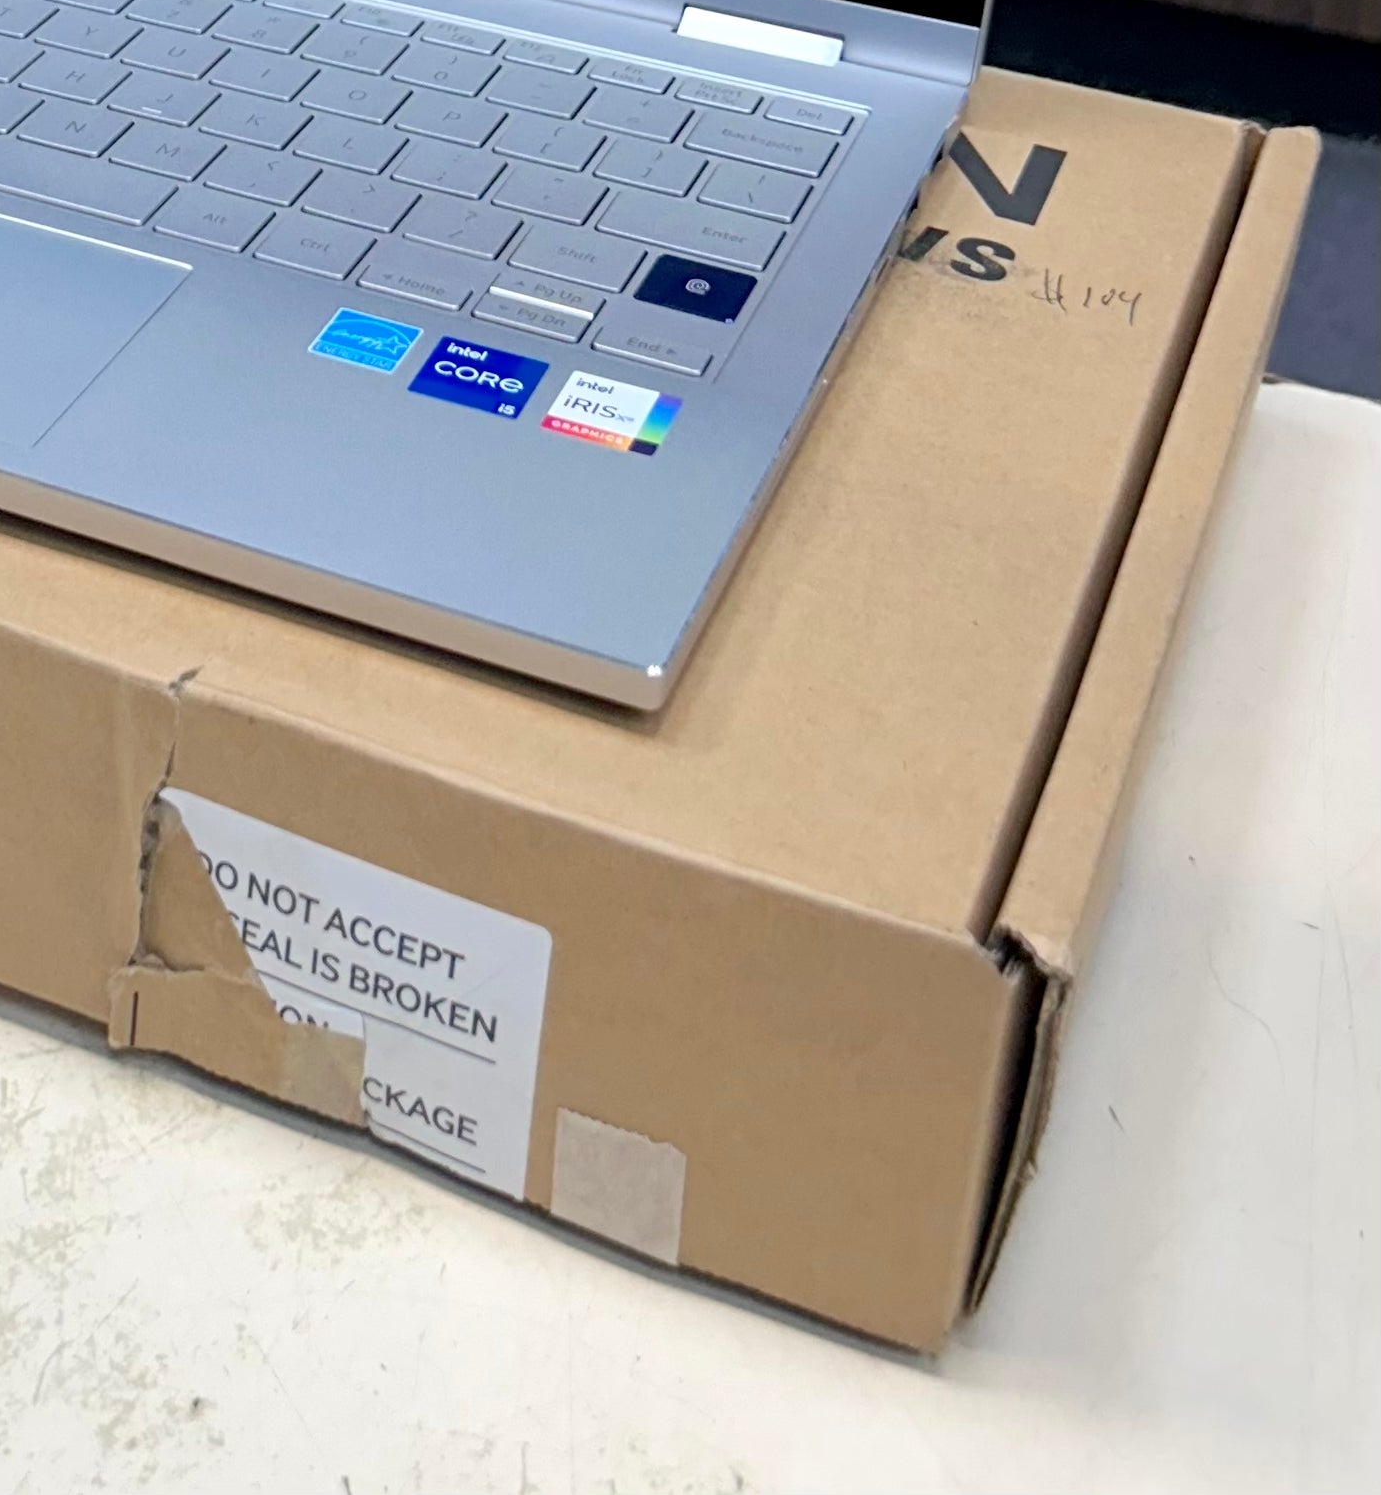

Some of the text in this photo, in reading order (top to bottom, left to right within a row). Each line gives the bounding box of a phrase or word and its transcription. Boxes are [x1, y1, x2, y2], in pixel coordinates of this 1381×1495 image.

[84, 25, 100, 38] Y
[167, 46, 188, 57] U
[64, 69, 87, 83] H
[156, 93, 174, 106] J
[245, 113, 268, 126] K
[442, 110, 462, 122] P
[63, 120, 88, 133] N
[155, 143, 181, 157] M
[342, 137, 355, 150] L
[202, 212, 228, 225] Alt
[701, 226, 749, 244] Enter
[300, 237, 332, 253] Ctrl
[556, 245, 597, 264] Shift
[397, 274, 446, 296] Home
[533, 283, 583, 305] Pg Up
[516, 307, 566, 329] Pg Dn
[447, 342, 489, 361] intel
[626, 336, 661, 355] End
[575, 377, 614, 395] intel
[497, 403, 516, 415] i5
[551, 419, 624, 445] GRAPHICS
[247, 871, 321, 925] NOT
[323, 907, 466, 980] ACCEPT
[311, 947, 340, 982] IS
[349, 963, 498, 1043] BROKEN
